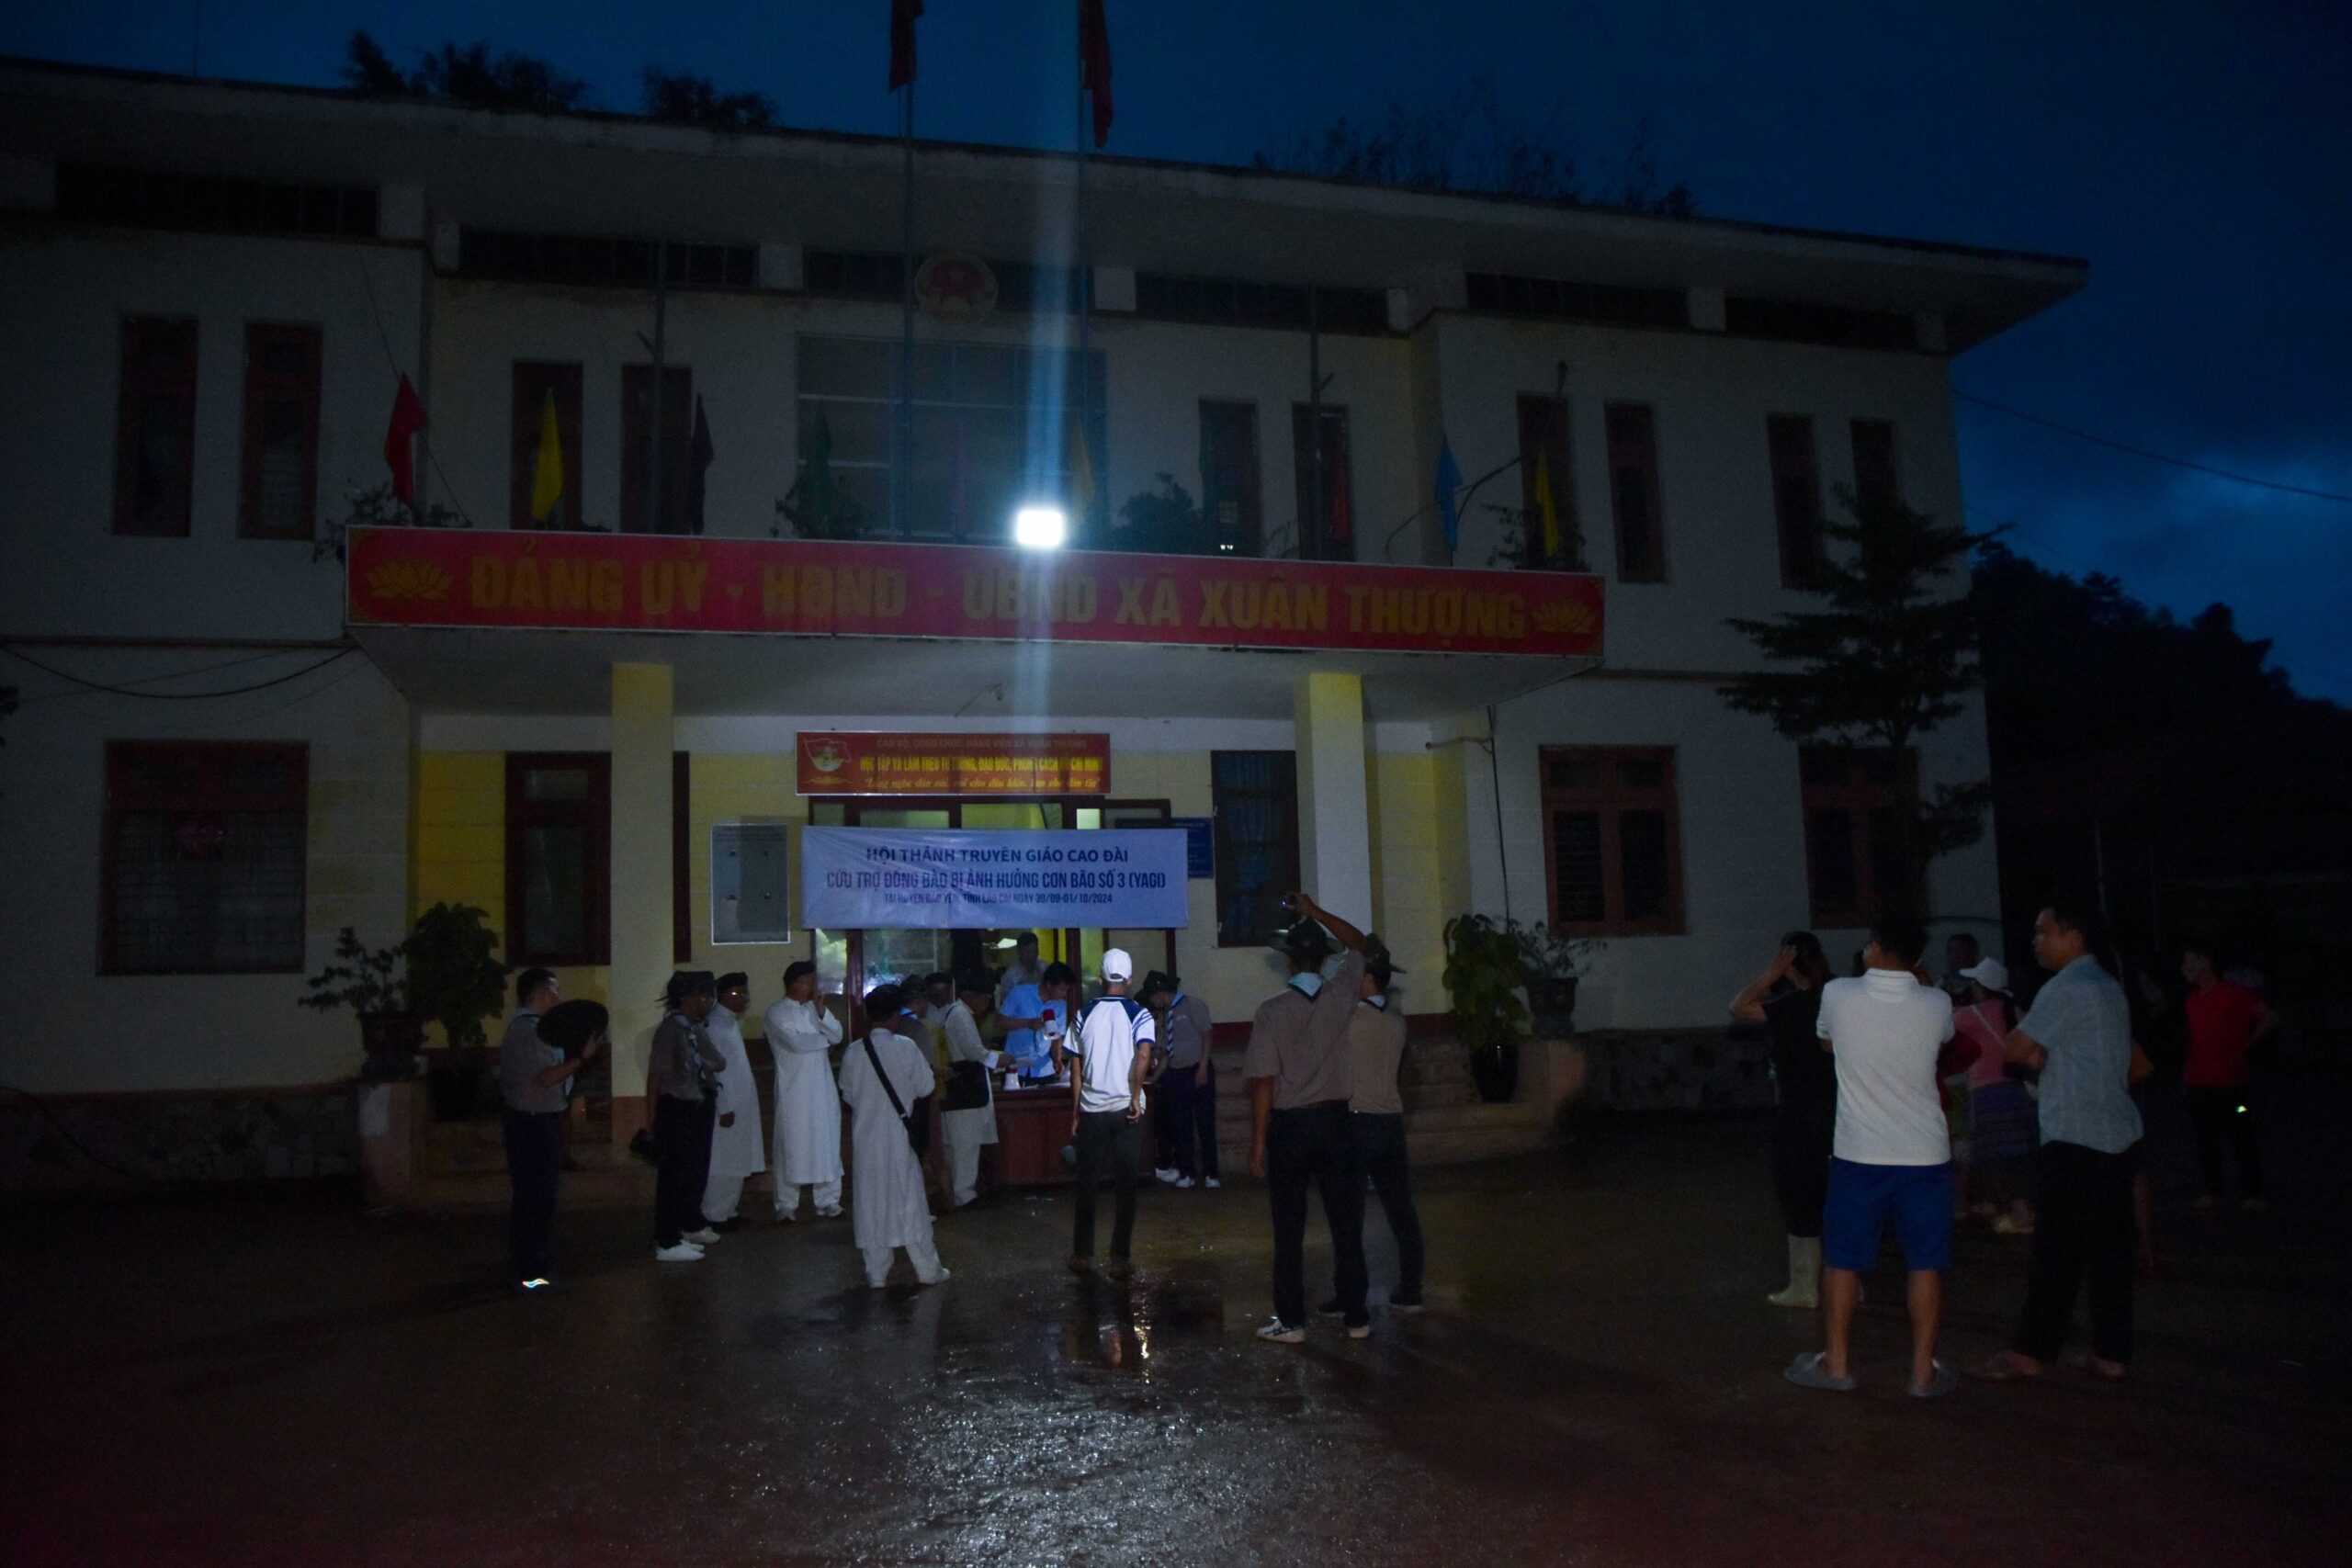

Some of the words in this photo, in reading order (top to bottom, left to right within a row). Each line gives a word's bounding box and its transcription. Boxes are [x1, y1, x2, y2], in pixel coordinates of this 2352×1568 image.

[470, 536, 625, 614] ĐẢNG
[762, 564, 907, 618] HĐND
[962, 566, 1098, 625] UBND
[1115, 567, 1181, 627] XÃ
[1198, 569, 1329, 633] XUÂN
[1345, 584, 1526, 647] THƯỢNG
[866, 846, 896, 865] HỘI
[899, 845, 956, 863] THÁNH
[1025, 845, 1064, 863] GIÁO
[1068, 849, 1099, 863] CAO
[1103, 846, 1129, 863] ĐÀI
[855, 871, 881, 892] TRỢ
[967, 868, 993, 888] ẢNH
[996, 868, 1039, 888] HƯỞNG
[1042, 872, 1068, 888] CƠN
[1070, 869, 1095, 888] BÃO
[1098, 867, 1116, 888] SỐ
[1117, 872, 1125, 888] 3
[1129, 872, 1166, 889] (YAGI)
